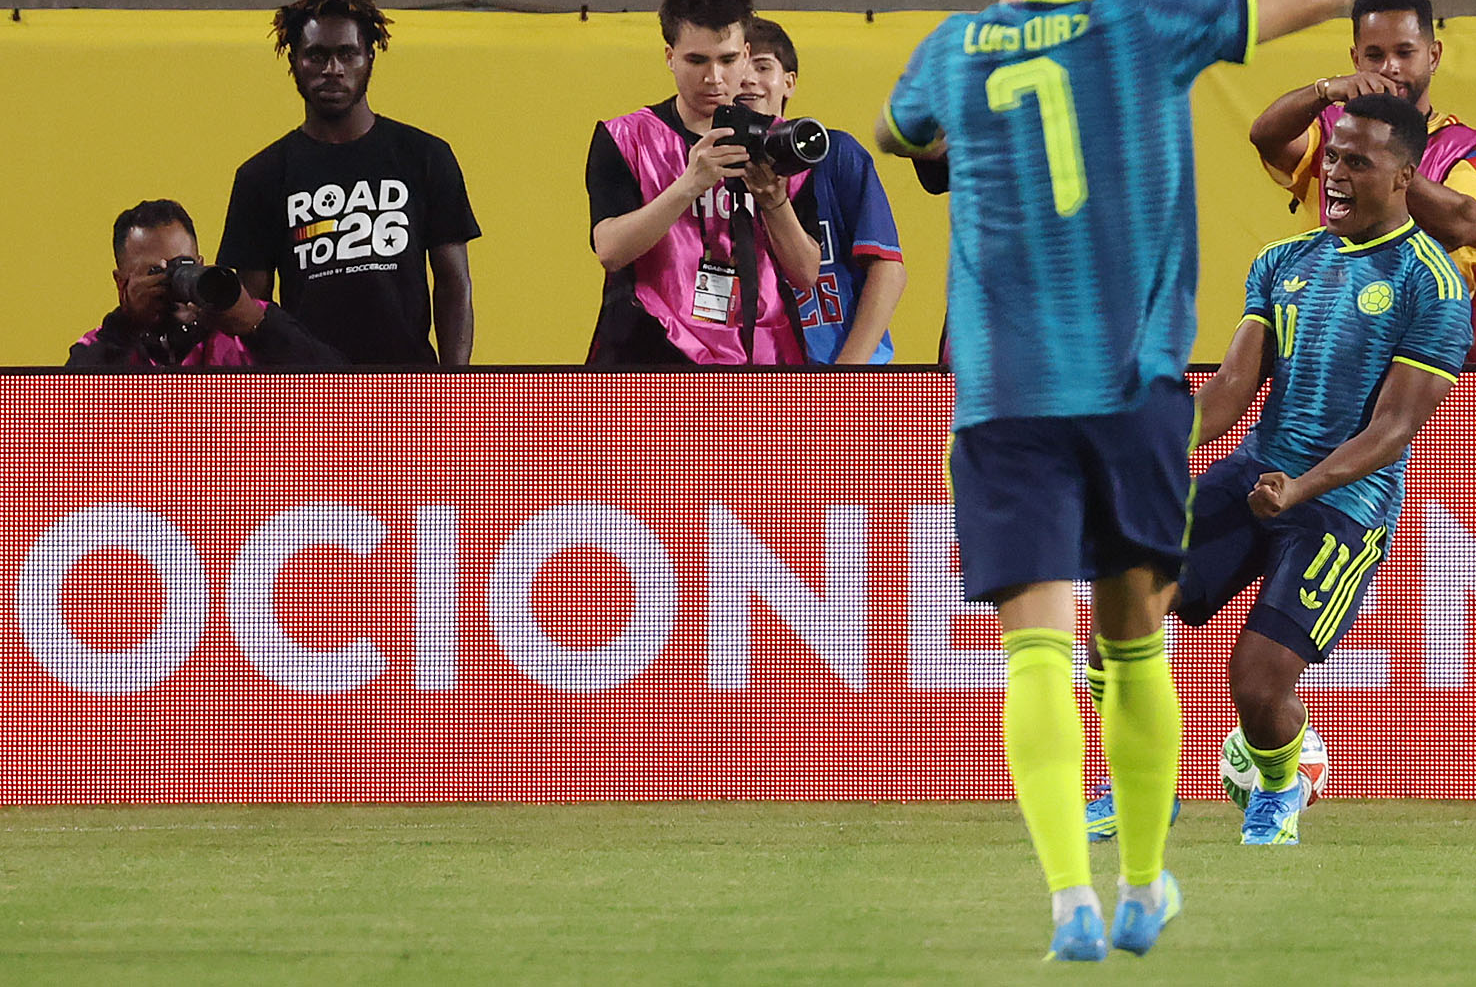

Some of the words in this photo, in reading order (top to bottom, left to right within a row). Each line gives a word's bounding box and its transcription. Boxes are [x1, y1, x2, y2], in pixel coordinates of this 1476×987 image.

[985, 56, 1089, 218] 7
[287, 179, 409, 228] ROAD
[293, 236, 335, 270] TO
[336, 211, 409, 261] 26
[1275, 303, 1298, 360] 11
[1303, 532, 1350, 592] 11
